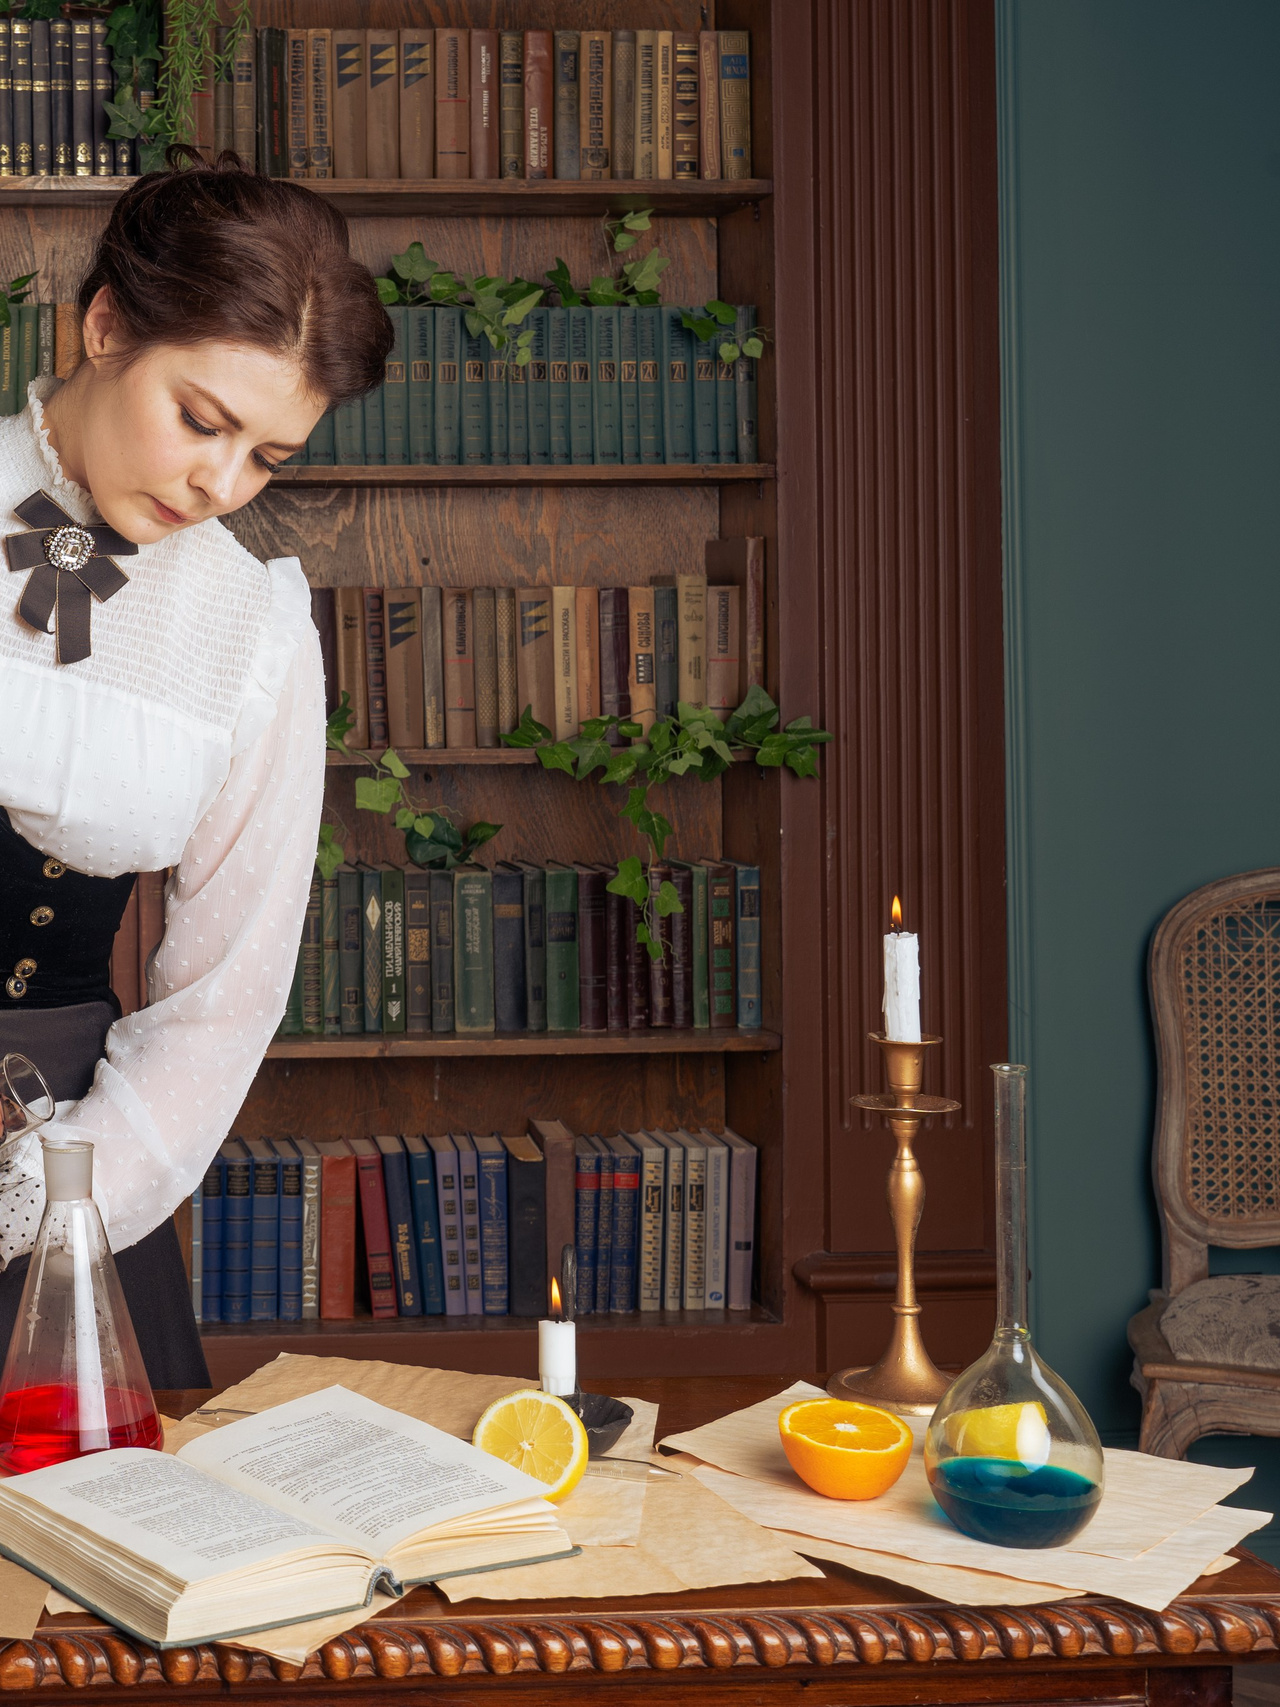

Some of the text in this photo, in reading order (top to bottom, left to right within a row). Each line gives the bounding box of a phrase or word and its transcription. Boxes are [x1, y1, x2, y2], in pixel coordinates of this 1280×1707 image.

[448, 37, 458, 98] К.ПАУСТОВСКИЙ
[723, 64, 747, 74] ЧЕХОВ
[290, 40, 308, 168] СТЕНДАЛЬ
[310, 38, 330, 167] СТЕНДАЛЬ
[584, 40, 608, 168] СТЕНДАЛЬ
[661, 86, 669, 123] ЖУКИ
[706, 79, 715, 118] УТРЕННЯЯ
[529, 108, 539, 168] ОТЕЦ ИАКИНФ
[3, 326, 11, 362] ШОЛОХО
[415, 316, 427, 356] БАЛЬЗАК
[442, 317, 456, 357] БАЛЬЗАК
[553, 317, 566, 357] БАЛЬЗАК
[573, 316, 586, 357] БАЛЬЗАК
[600, 316, 613, 357] БАЛЬЗАК
[415, 364, 428, 379] 10
[443, 366, 454, 380] 11
[468, 364, 482, 379] 12
[533, 364, 545, 380] 15
[553, 364, 566, 380] 16
[574, 365, 587, 380] 17
[601, 364, 614, 380] 18
[623, 364, 635, 380] 19
[643, 364, 657, 380] 20
[672, 364, 685, 379] 21
[698, 363, 712, 379] 22
[456, 593, 466, 655] К.ПАУСТОВСКИЙ
[638, 612, 650, 647] СЫНОВЬЯ
[718, 591, 729, 654] К.ПАУСТОВСКИЙ
[386, 901, 394, 978] П.И.МЕЛЬНИКОВ
[404, 1291, 414, 1306] 3
